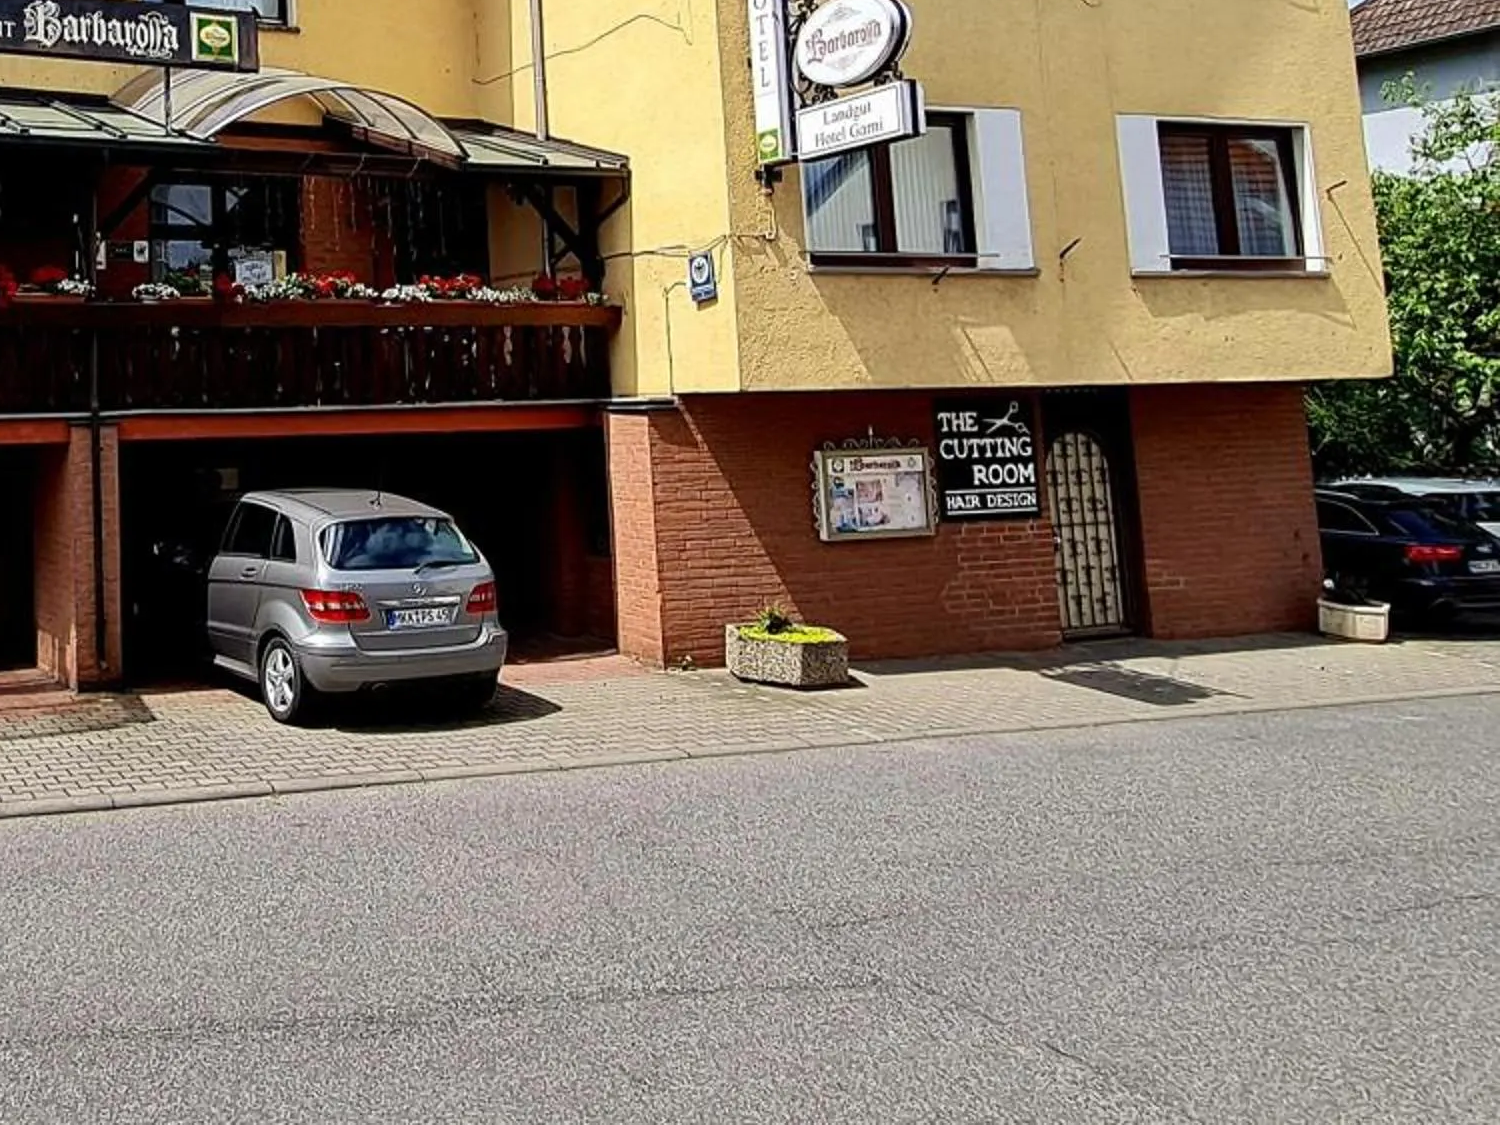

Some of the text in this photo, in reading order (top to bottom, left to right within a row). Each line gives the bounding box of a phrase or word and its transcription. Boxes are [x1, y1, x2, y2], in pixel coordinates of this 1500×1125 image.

[822, 101, 872, 125] Landgut
[815, 127, 847, 148] Hotel
[937, 411, 979, 433] THE
[939, 436, 1033, 460] CUTTING
[972, 462, 1036, 486] ROOM
[946, 491, 1037, 510] HAIR DESIGN
